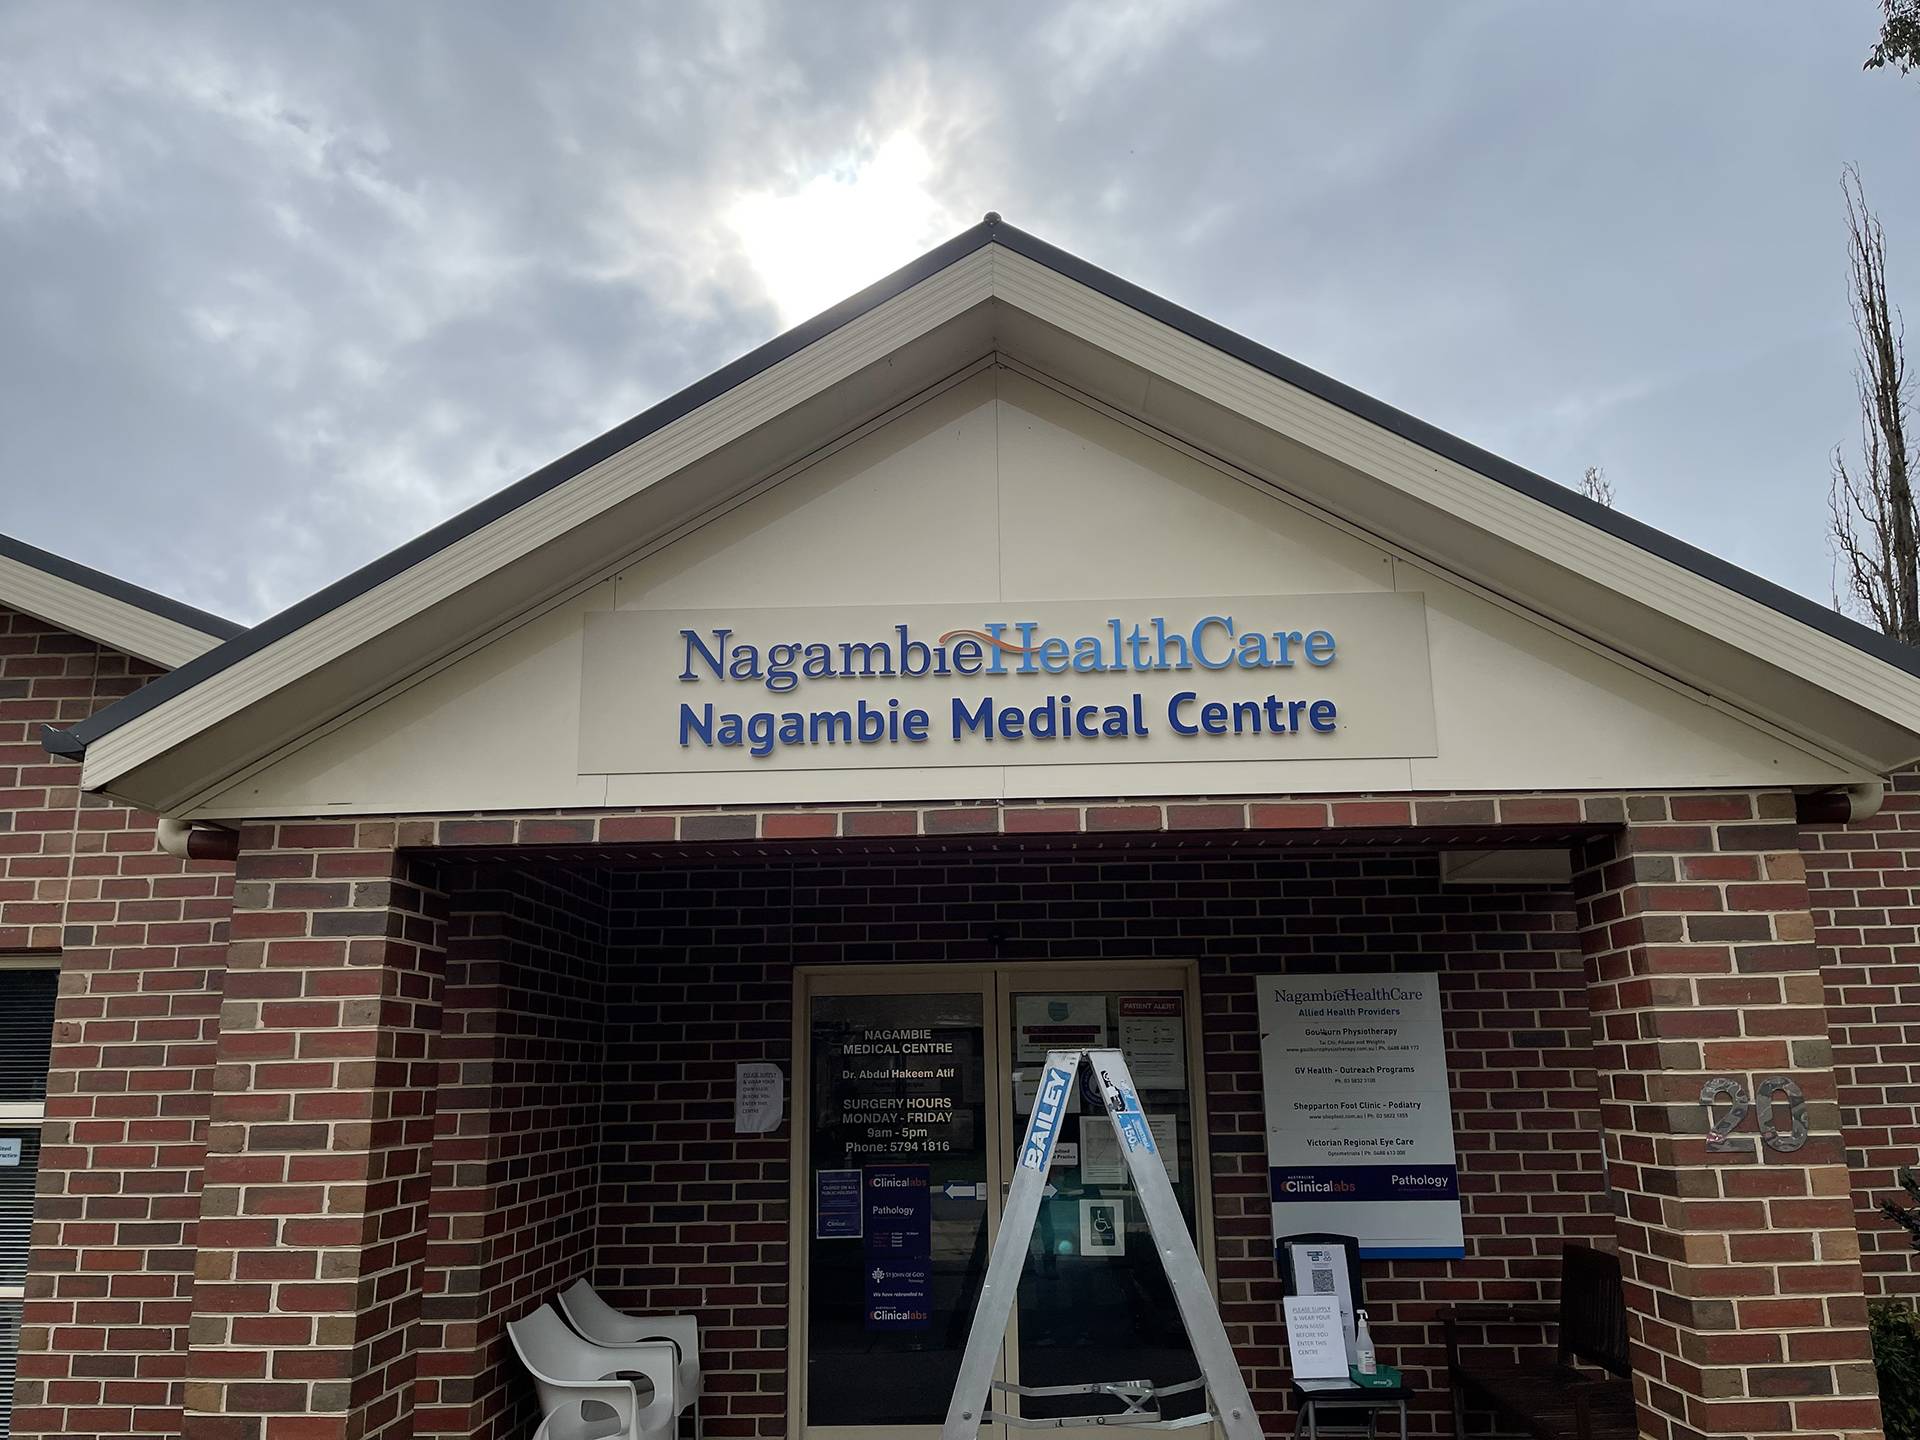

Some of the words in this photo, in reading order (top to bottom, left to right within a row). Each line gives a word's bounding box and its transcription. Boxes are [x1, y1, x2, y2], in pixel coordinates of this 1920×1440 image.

[679, 616, 1336, 692] NagambieHealthCare
[679, 699, 929, 756] Nagambie
[951, 694, 1148, 739] Medical
[1167, 692, 1336, 736] Centre
[1274, 988, 1422, 1005] NagambieHealthCare
[1298, 1009, 1324, 1017] Allied
[1327, 1008, 1356, 1016] Health
[1358, 1008, 1400, 1016] Providers
[864, 1029, 932, 1040] NAGAMBIE
[1343, 1028, 1398, 1037] Physiotherapy
[843, 1044, 900, 1054] MEDICAL
[902, 1043, 953, 1053] CENTRE
[842, 1070, 857, 1079] Dr.
[859, 1070, 889, 1079] Abdul
[891, 1069, 934, 1078] Hakeem
[936, 1068, 955, 1078] Atif
[1377, 1066, 1415, 1074] Programs
[843, 1099, 904, 1110] SURGERY
[906, 1098, 952, 1109] HOURS
[1294, 1102, 1339, 1111] Shepparton
[1388, 1101, 1421, 1110] Podiatry
[842, 1113, 898, 1124] MONDAY
[907, 1112, 953, 1122] FRIDAY
[1024, 1068, 1065, 1169] BAILEY
[1699, 1076, 1810, 1153] 20
[867, 1128, 892, 1138] 9am
[901, 1128, 928, 1140] 5pm
[845, 1142, 887, 1152] Phone:
[889, 1141, 919, 1151] 5794
[922, 1141, 950, 1151] 1816
[1343, 1138, 1378, 1147] Regional
[1380, 1138, 1393, 1147] Eye
[872, 1177, 928, 1188] Clinicalabs
[1284, 1180, 1356, 1193] Clinicalabs
[1391, 1175, 1448, 1187] Pathology
[872, 1205, 914, 1216] Pathology
[872, 1310, 928, 1321] Clinicalabs
